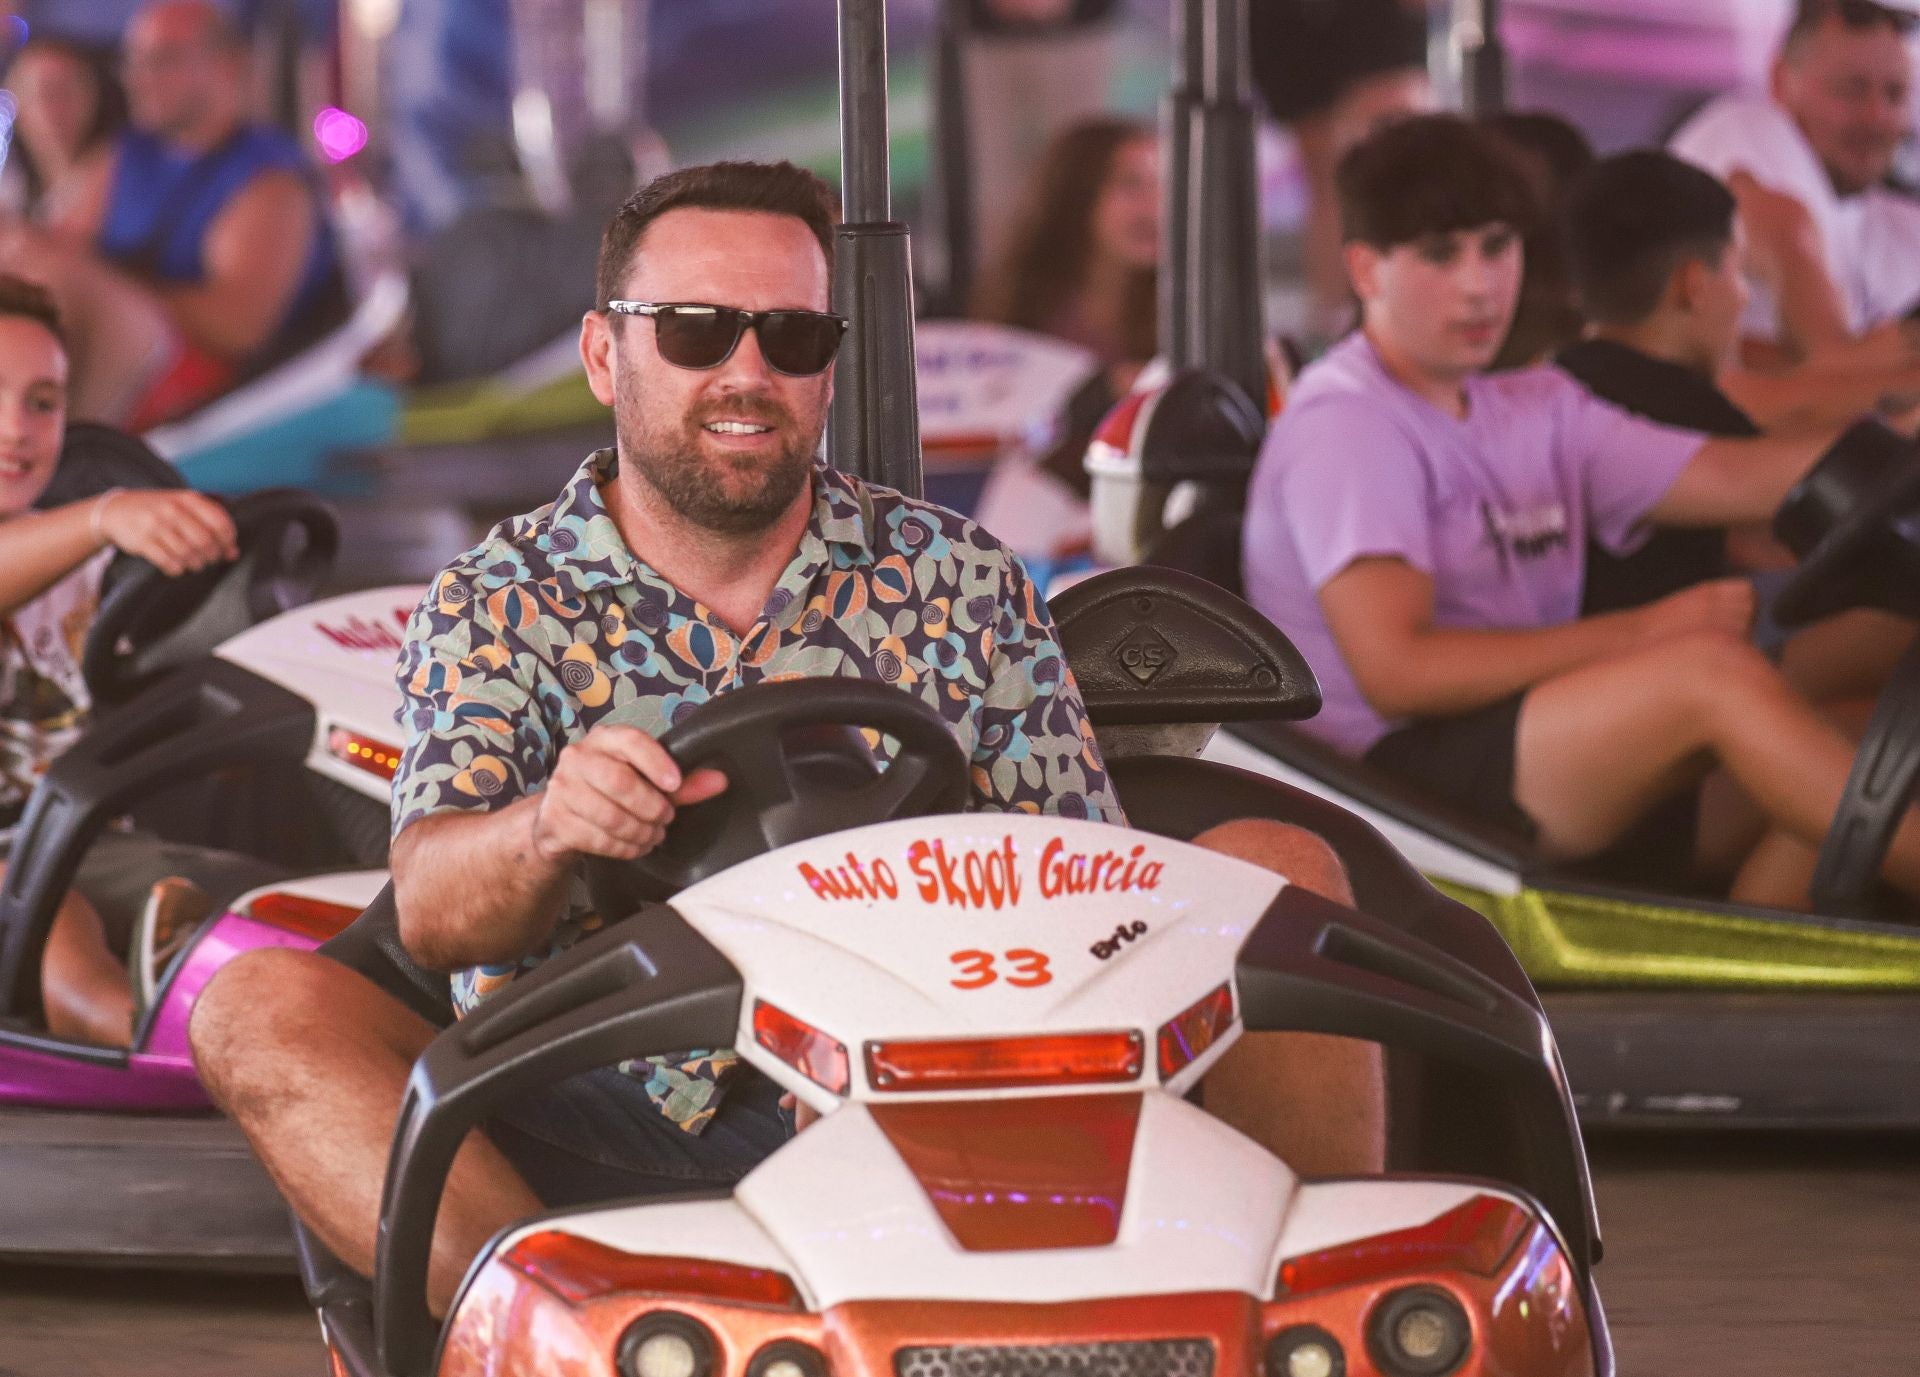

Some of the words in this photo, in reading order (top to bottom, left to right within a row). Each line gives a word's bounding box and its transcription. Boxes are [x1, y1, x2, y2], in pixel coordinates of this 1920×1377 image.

[798, 851, 898, 900] Auto
[907, 835, 1021, 910] Skoot
[1039, 837, 1164, 899] Garcia
[950, 949, 1052, 989] 33
